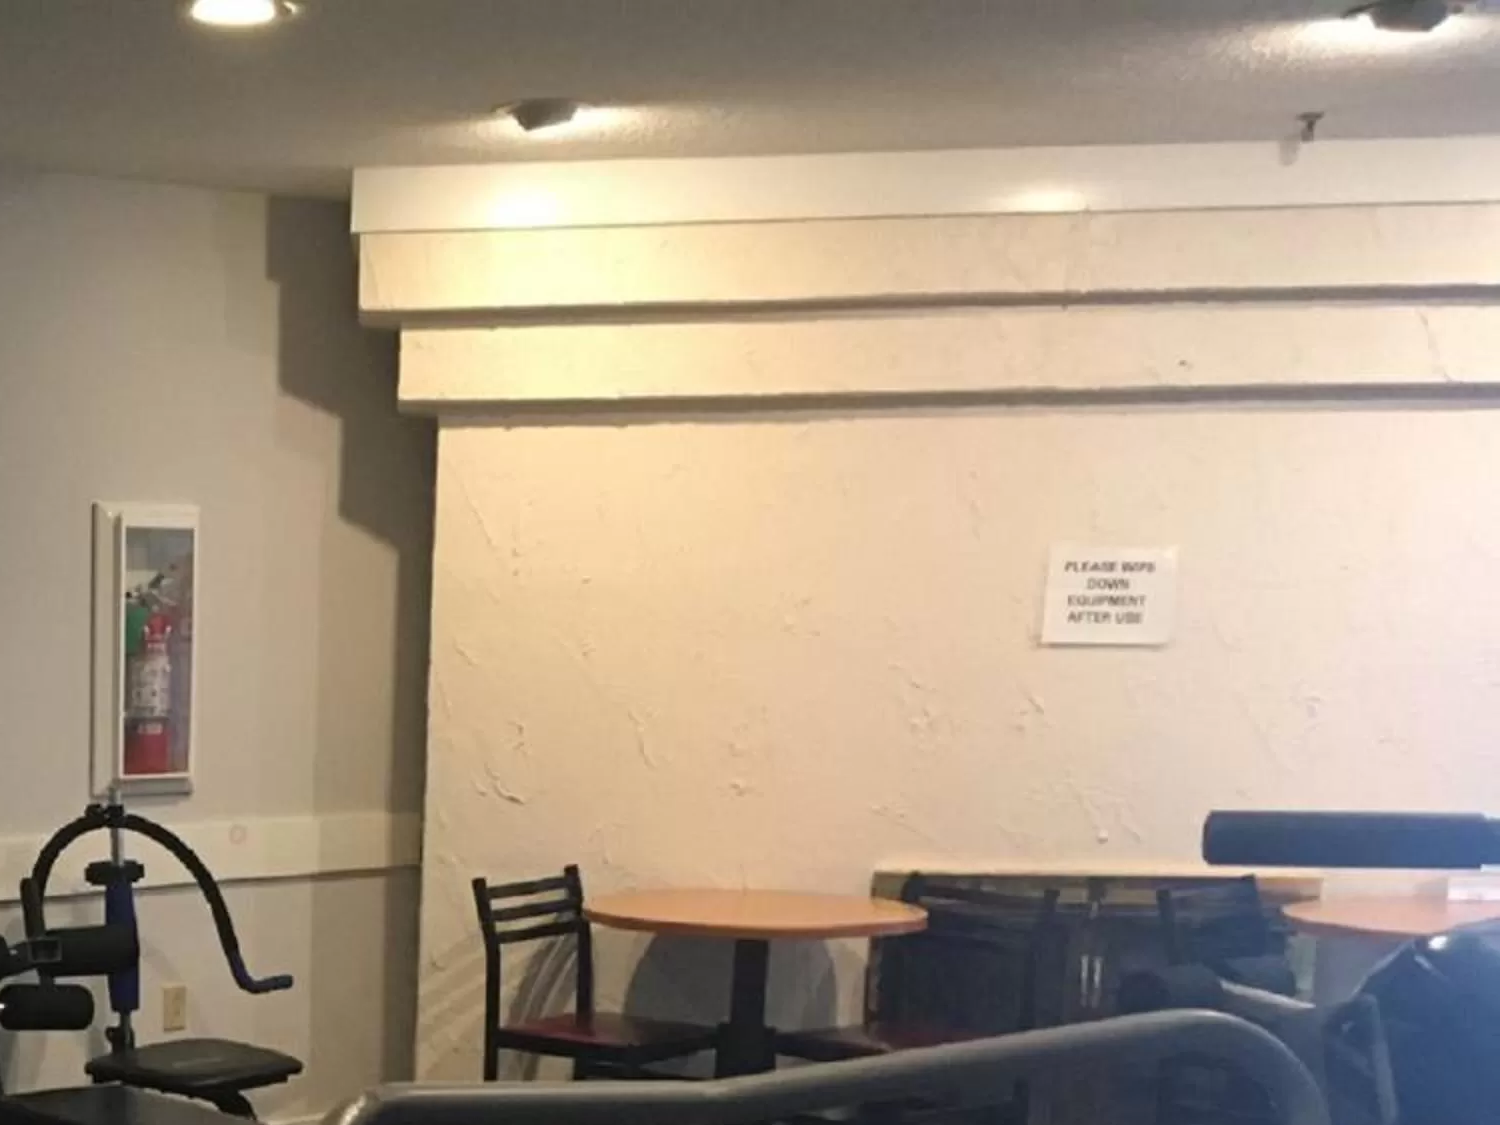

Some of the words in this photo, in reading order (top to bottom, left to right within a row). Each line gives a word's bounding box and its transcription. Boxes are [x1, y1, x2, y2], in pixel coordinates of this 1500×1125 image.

[1064, 560, 1118, 573] PLEASE
[1086, 577, 1130, 590] DOWN
[1067, 594, 1147, 607] EQUIPMENT
[1067, 611, 1111, 624] AFTER
[1115, 611, 1143, 625] USE
